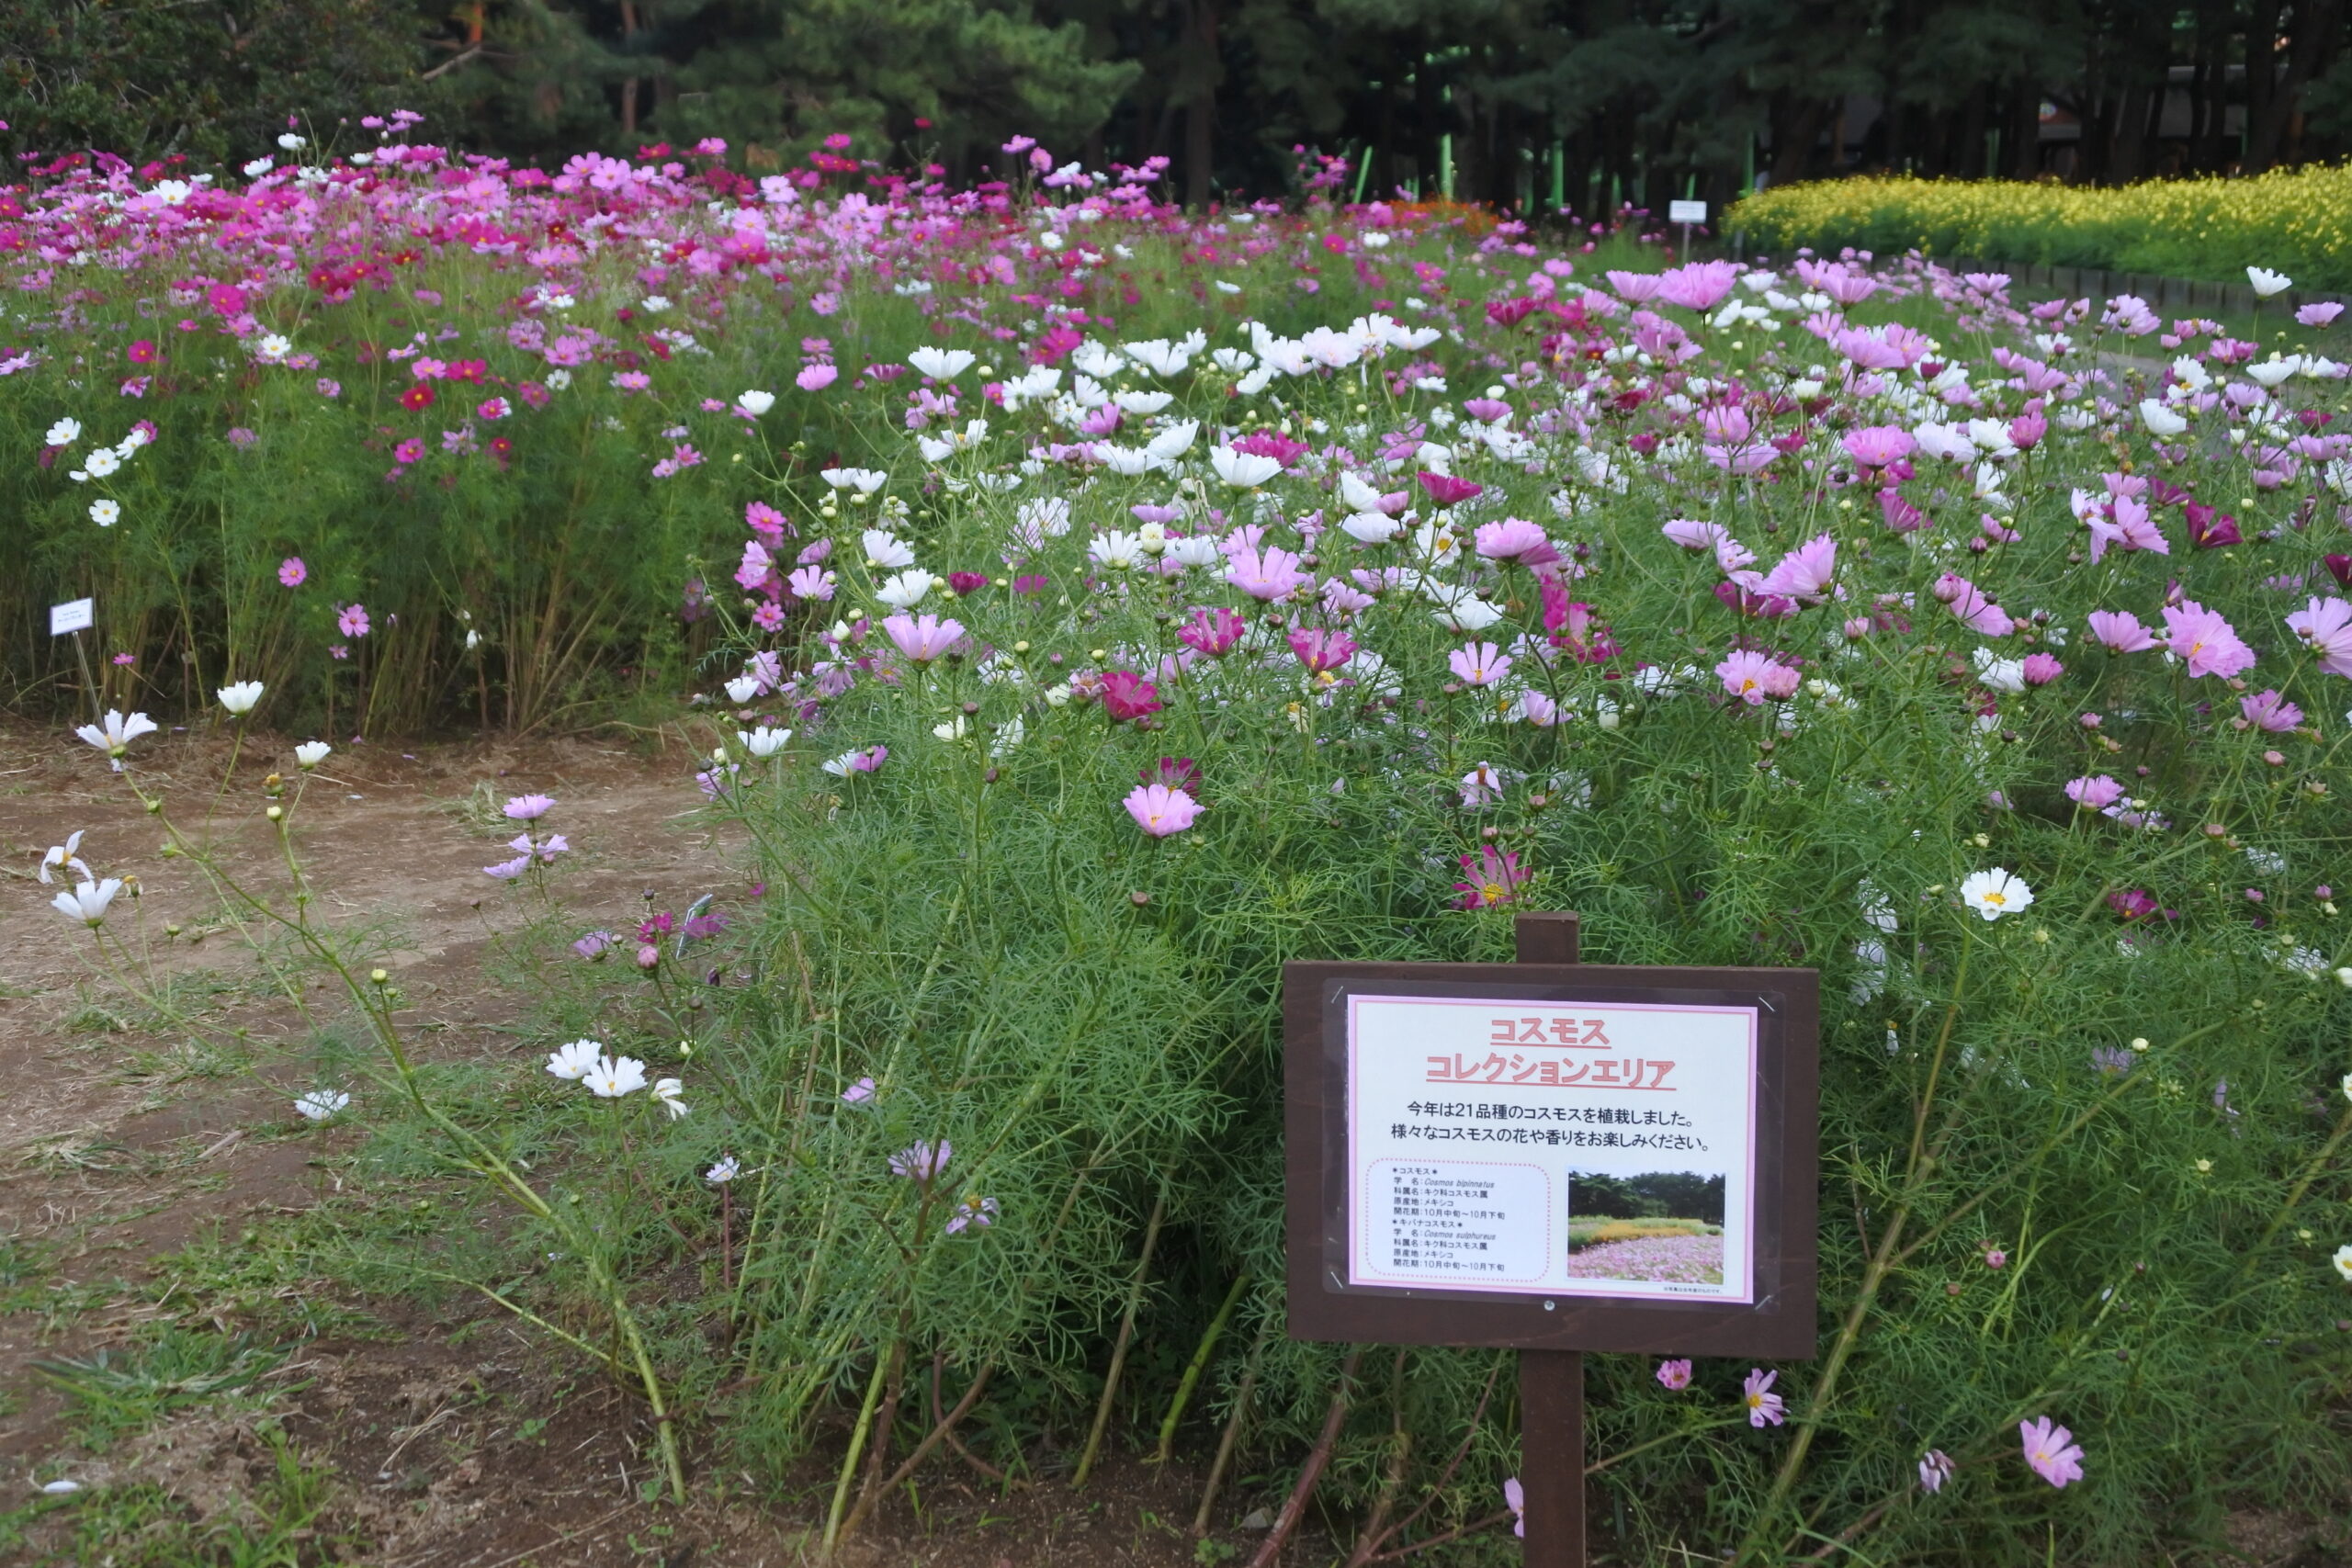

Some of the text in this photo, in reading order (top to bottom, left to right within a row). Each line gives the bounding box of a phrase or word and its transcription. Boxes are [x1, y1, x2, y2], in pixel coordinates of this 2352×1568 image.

[1491, 1017, 1611, 1045] コスモス
[1427, 1053, 1676, 1089] コレクションエリア
[1408, 1100, 1693, 1127] 今年は21品種のコスモスを植栽しました。
[1391, 1123, 1709, 1152] 様々なコスモスの花や香りをお楽しみください。
